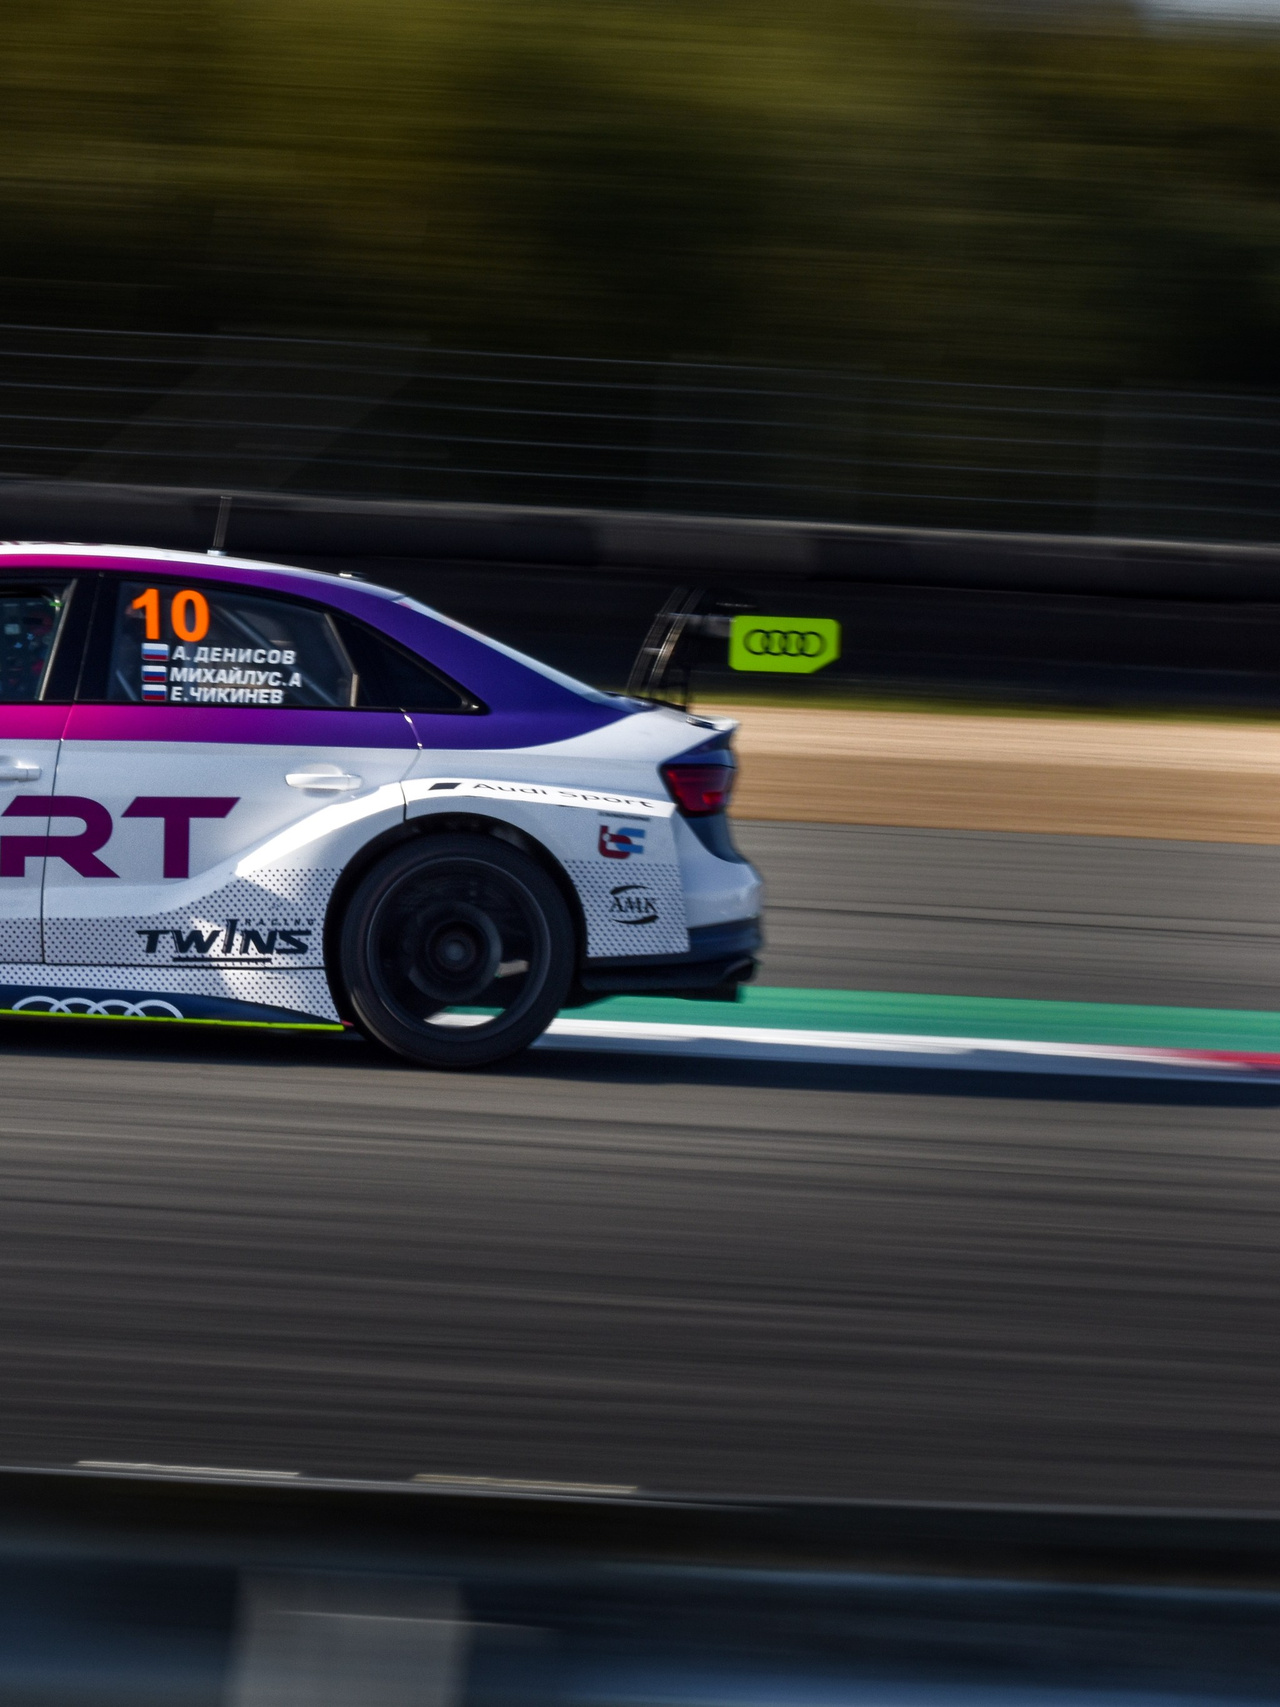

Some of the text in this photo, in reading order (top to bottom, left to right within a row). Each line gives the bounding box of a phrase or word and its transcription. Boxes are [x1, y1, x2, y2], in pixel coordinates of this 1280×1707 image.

[131, 588, 211, 643] 10
[193, 646, 297, 665] ДЕНИСОВ
[473, 783, 547, 796] Audi
[244, 918, 315, 927] RACING
[135, 918, 313, 954] TWINS
